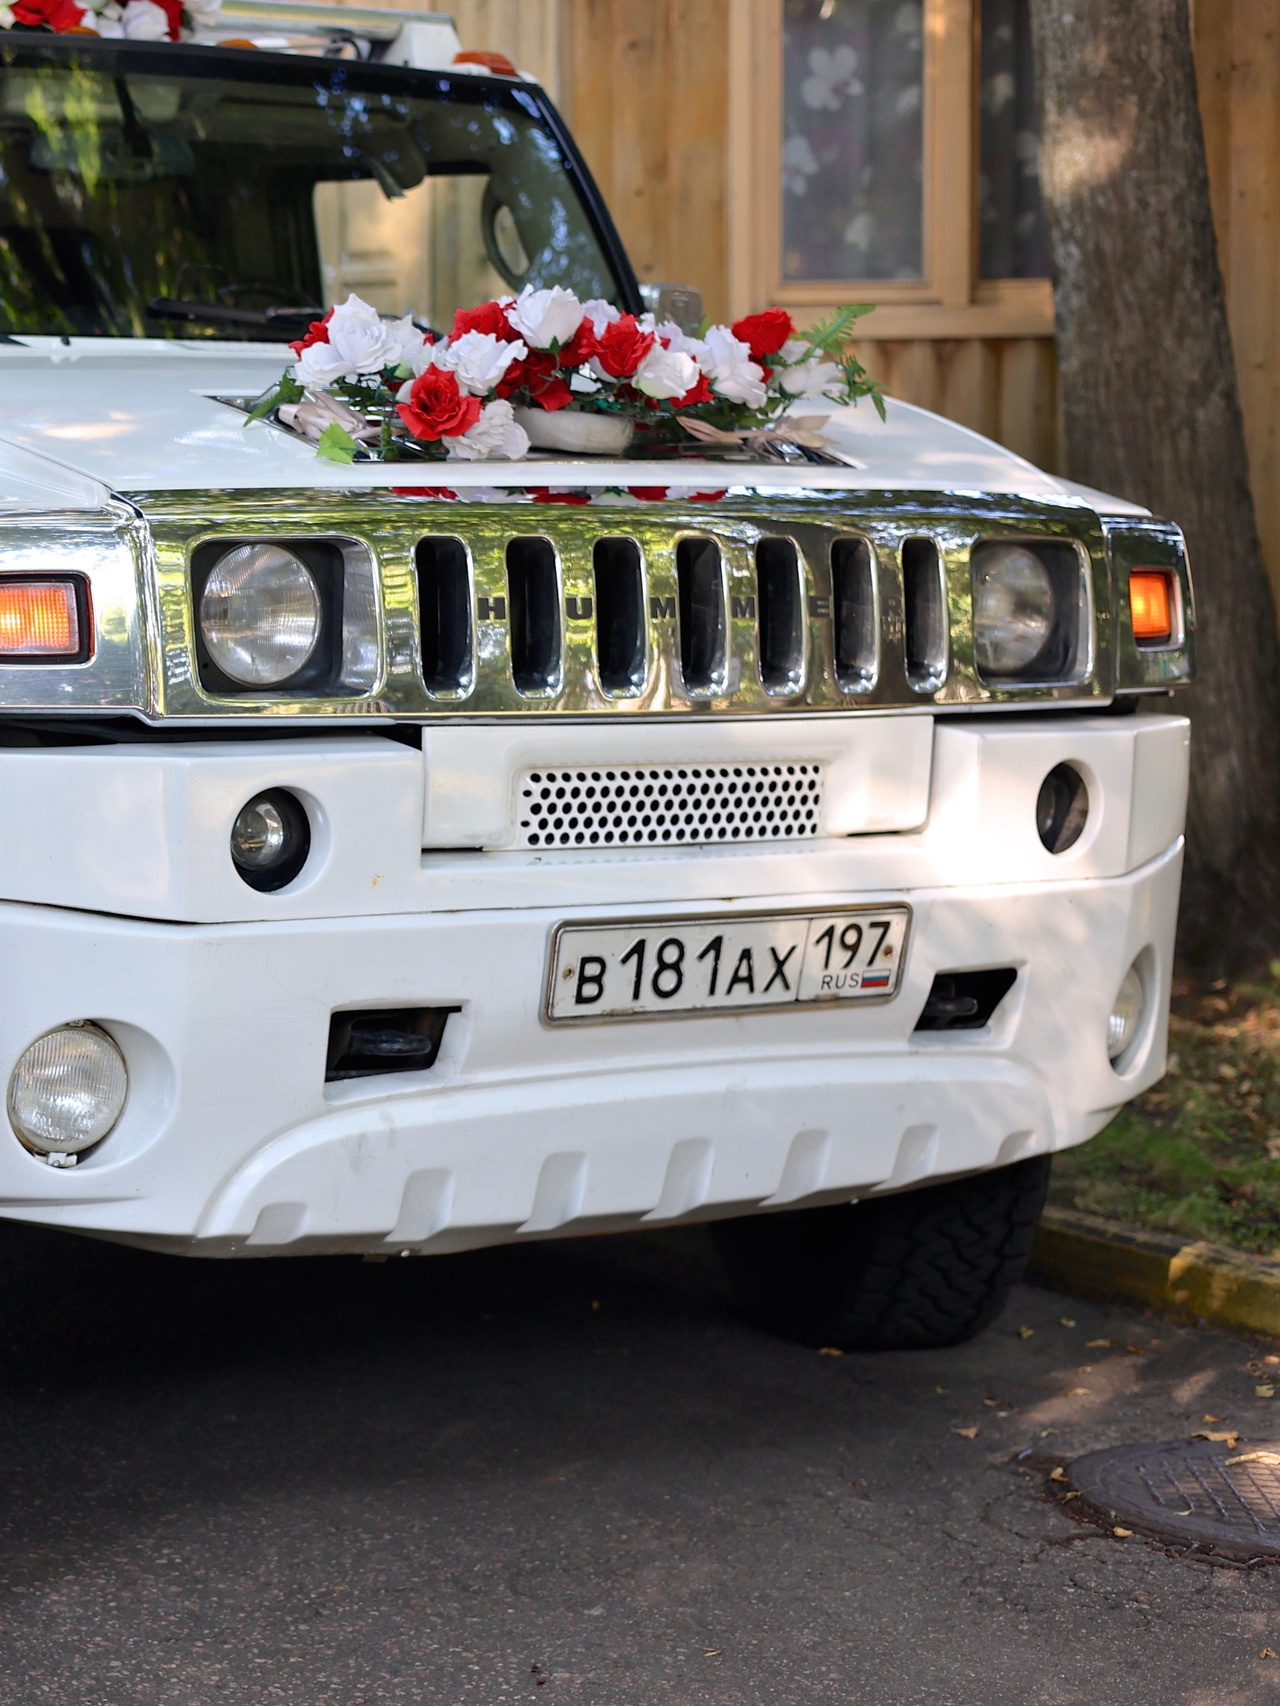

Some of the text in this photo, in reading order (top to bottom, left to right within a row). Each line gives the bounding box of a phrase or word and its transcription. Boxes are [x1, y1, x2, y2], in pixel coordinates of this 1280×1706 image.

[477, 596, 902, 621] HUMMER
[814, 921, 891, 971] 197
[821, 972, 860, 990] RUS
